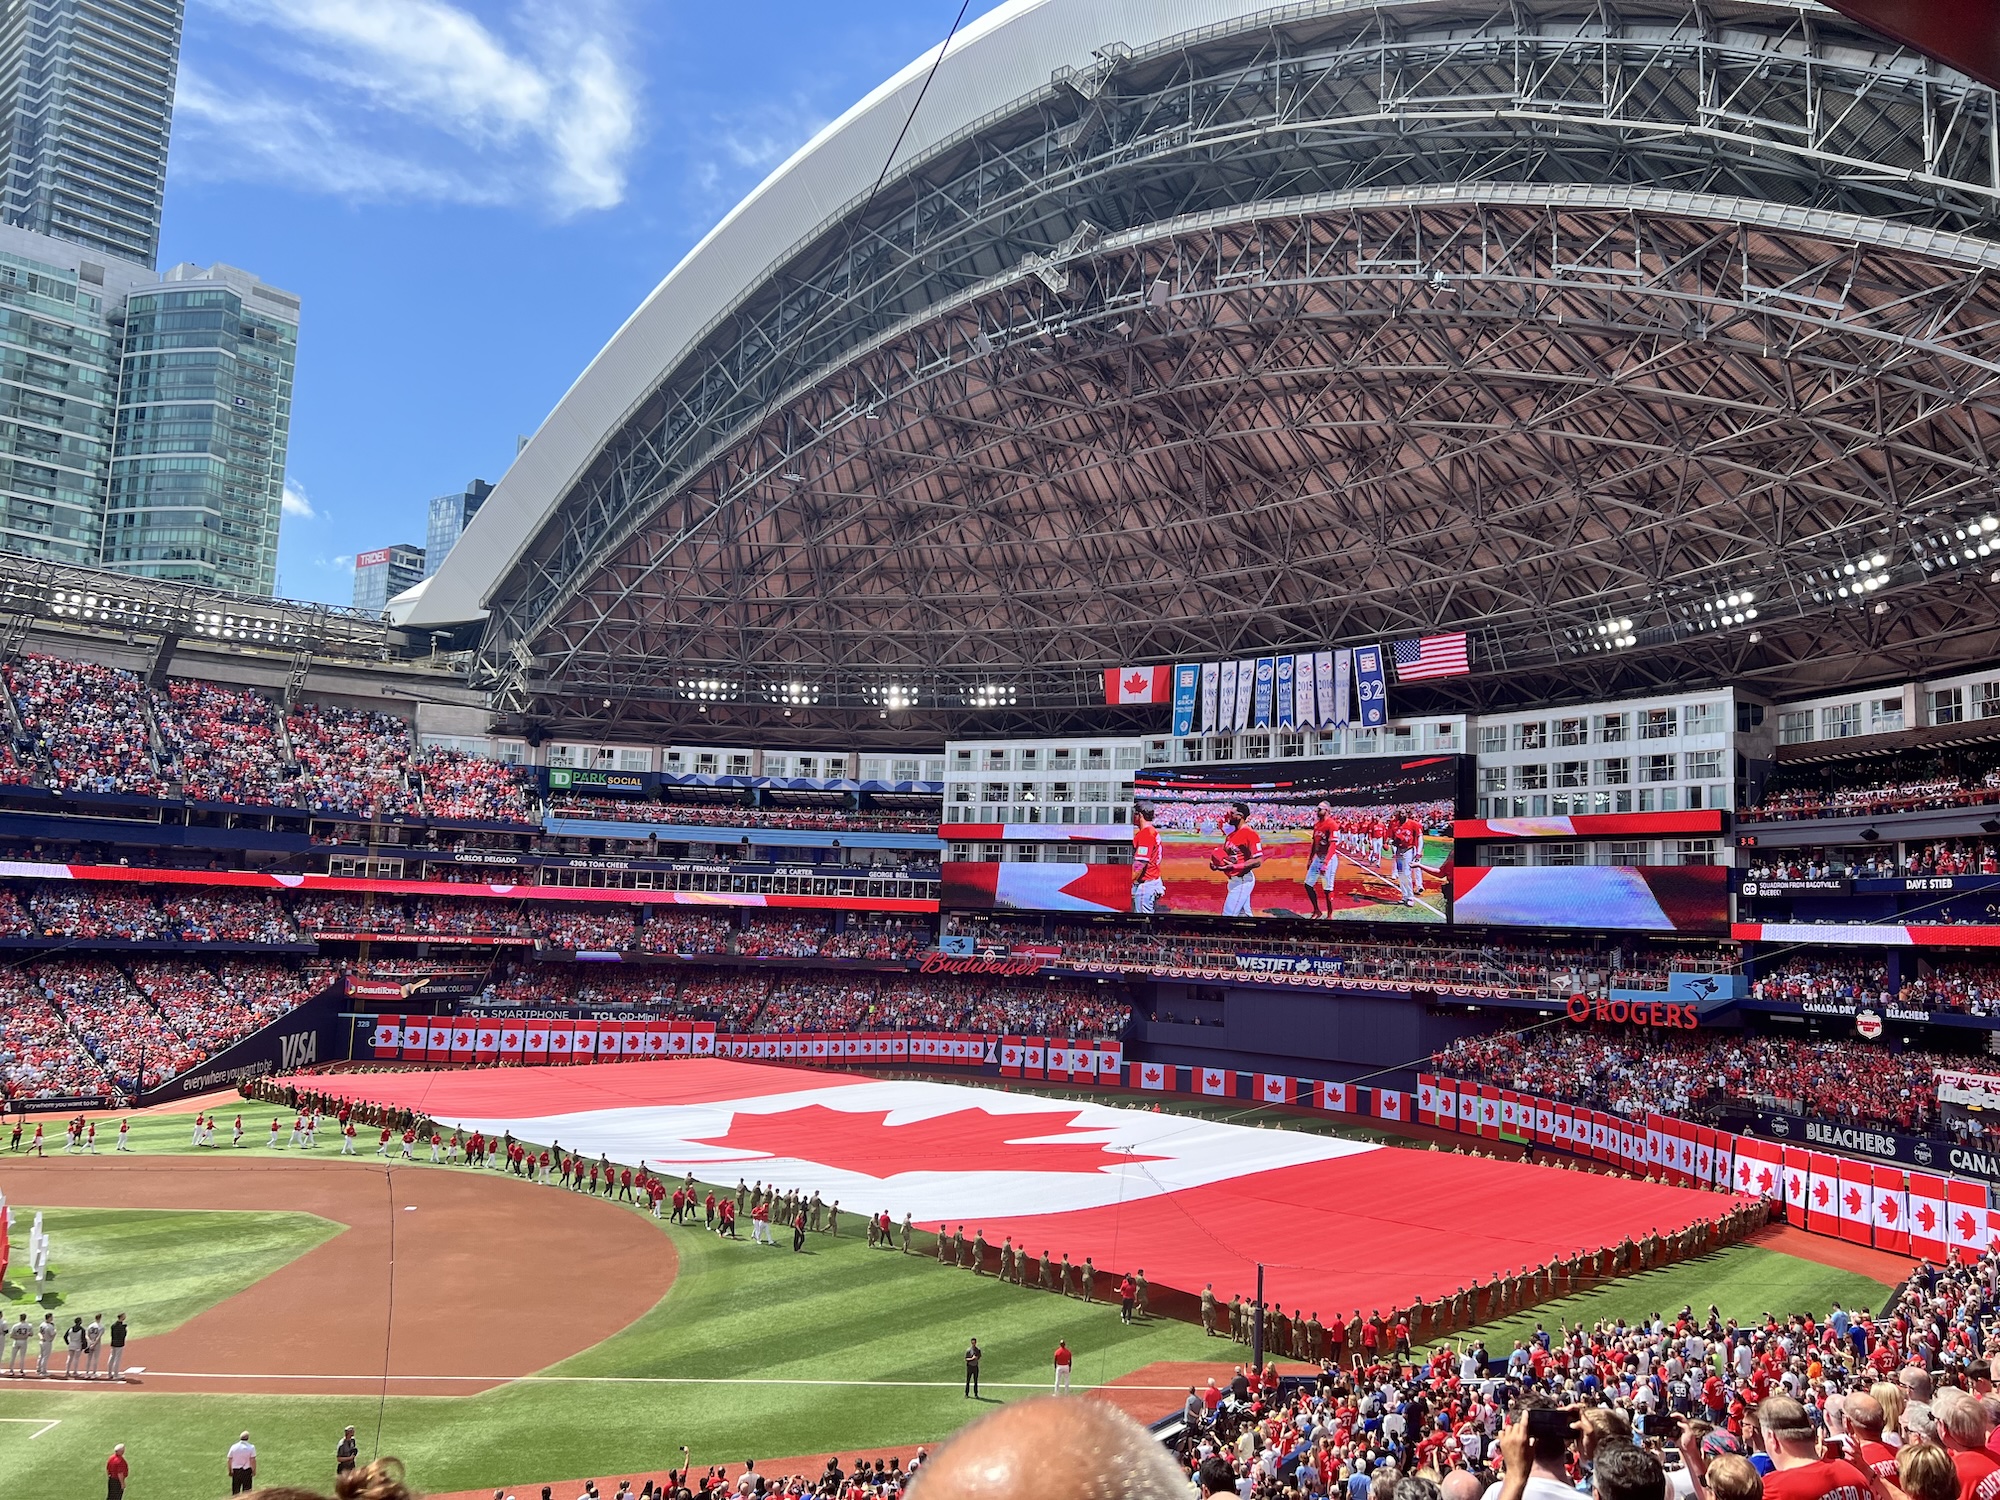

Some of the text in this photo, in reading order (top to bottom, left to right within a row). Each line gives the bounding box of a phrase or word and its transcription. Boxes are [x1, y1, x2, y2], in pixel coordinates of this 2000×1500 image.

[361, 552, 386, 565] TRIDEL
[1258, 684, 1270, 694] 1992
[1298, 681, 1312, 691] 2015
[1360, 680, 1384, 701] 32
[552, 772, 570, 785] TD
[573, 772, 642, 786] PARK SOCIAL
[455, 854, 518, 864] CARLOS DELGADO
[692, 865, 730, 873] FERNANDEZ
[1760, 881, 1788, 889] SQUADRON
[1906, 878, 1953, 890] DAVE STIEB
[916, 951, 1040, 976] Budweiser
[1236, 956, 1342, 972] WESTJET FLIGHT
[357, 986, 400, 994] BeautiTone
[420, 986, 447, 994] RETHINK
[462, 1010, 570, 1019] TCL SMARTPHONE
[1596, 1000, 1698, 1030] ROGERS
[1802, 1003, 1856, 1015] CANADA DRY
[1886, 1008, 1930, 1021] BLEACHERS
[591, 1012, 616, 1020] TCL
[279, 1030, 317, 1069] VISA
[183, 1070, 226, 1090] everywhere
[226, 1067, 240, 1084] you
[256, 1062, 264, 1074] to
[264, 1058, 273, 1073] be
[55, 1101, 67, 1109] you
[1806, 1122, 1896, 1156] BLEACHERS
[1674, 1387, 1686, 1398] 99
